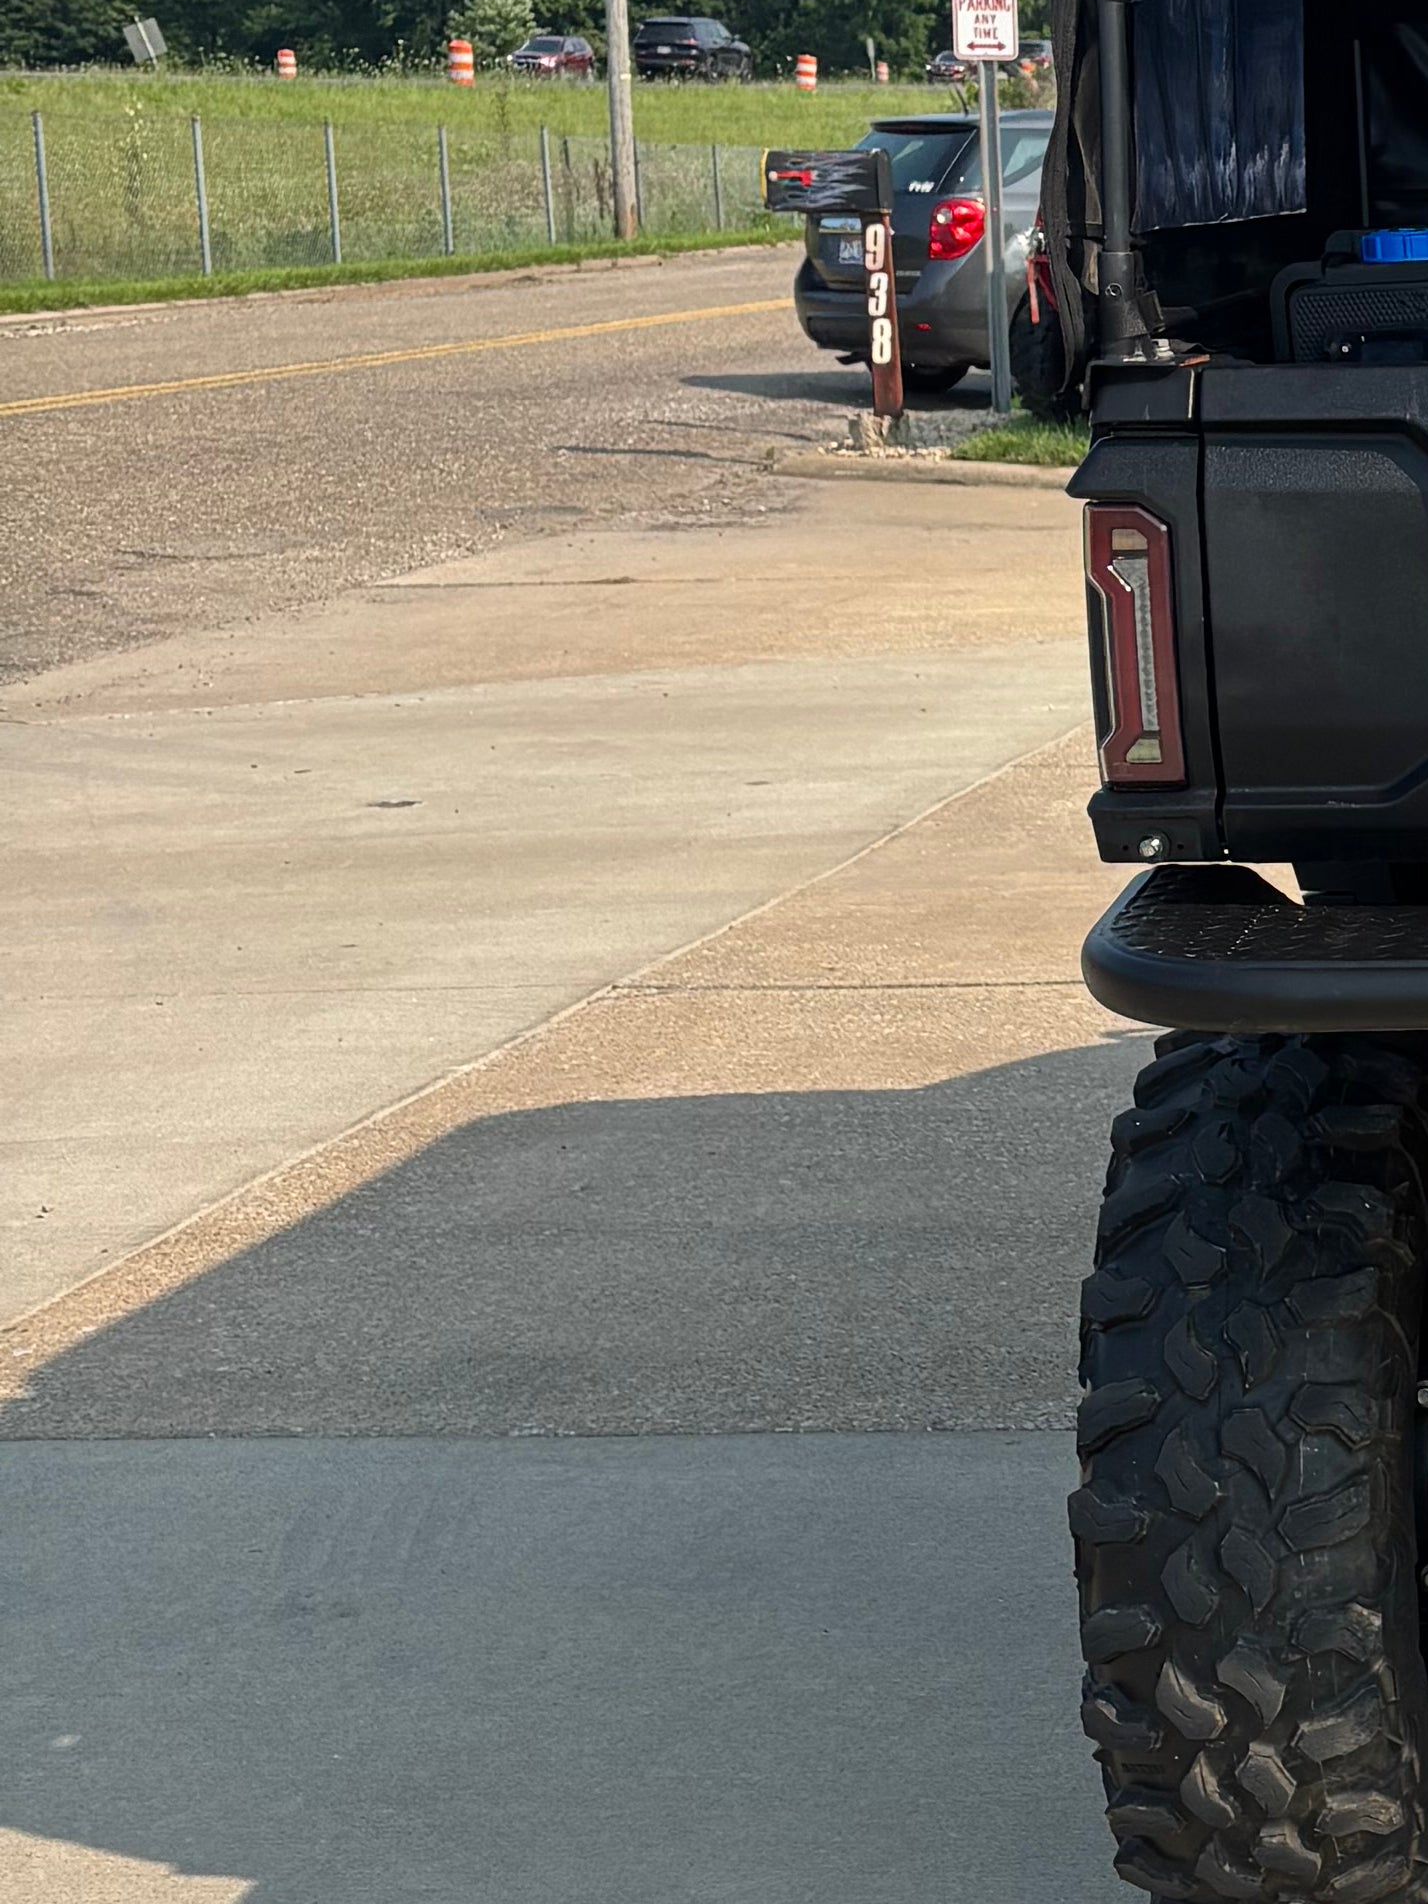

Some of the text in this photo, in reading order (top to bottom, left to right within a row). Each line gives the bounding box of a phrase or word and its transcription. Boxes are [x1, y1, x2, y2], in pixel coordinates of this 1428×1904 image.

[974, 14, 997, 25] ANY
[973, 27, 999, 40] TIME
[864, 223, 892, 365] 938
